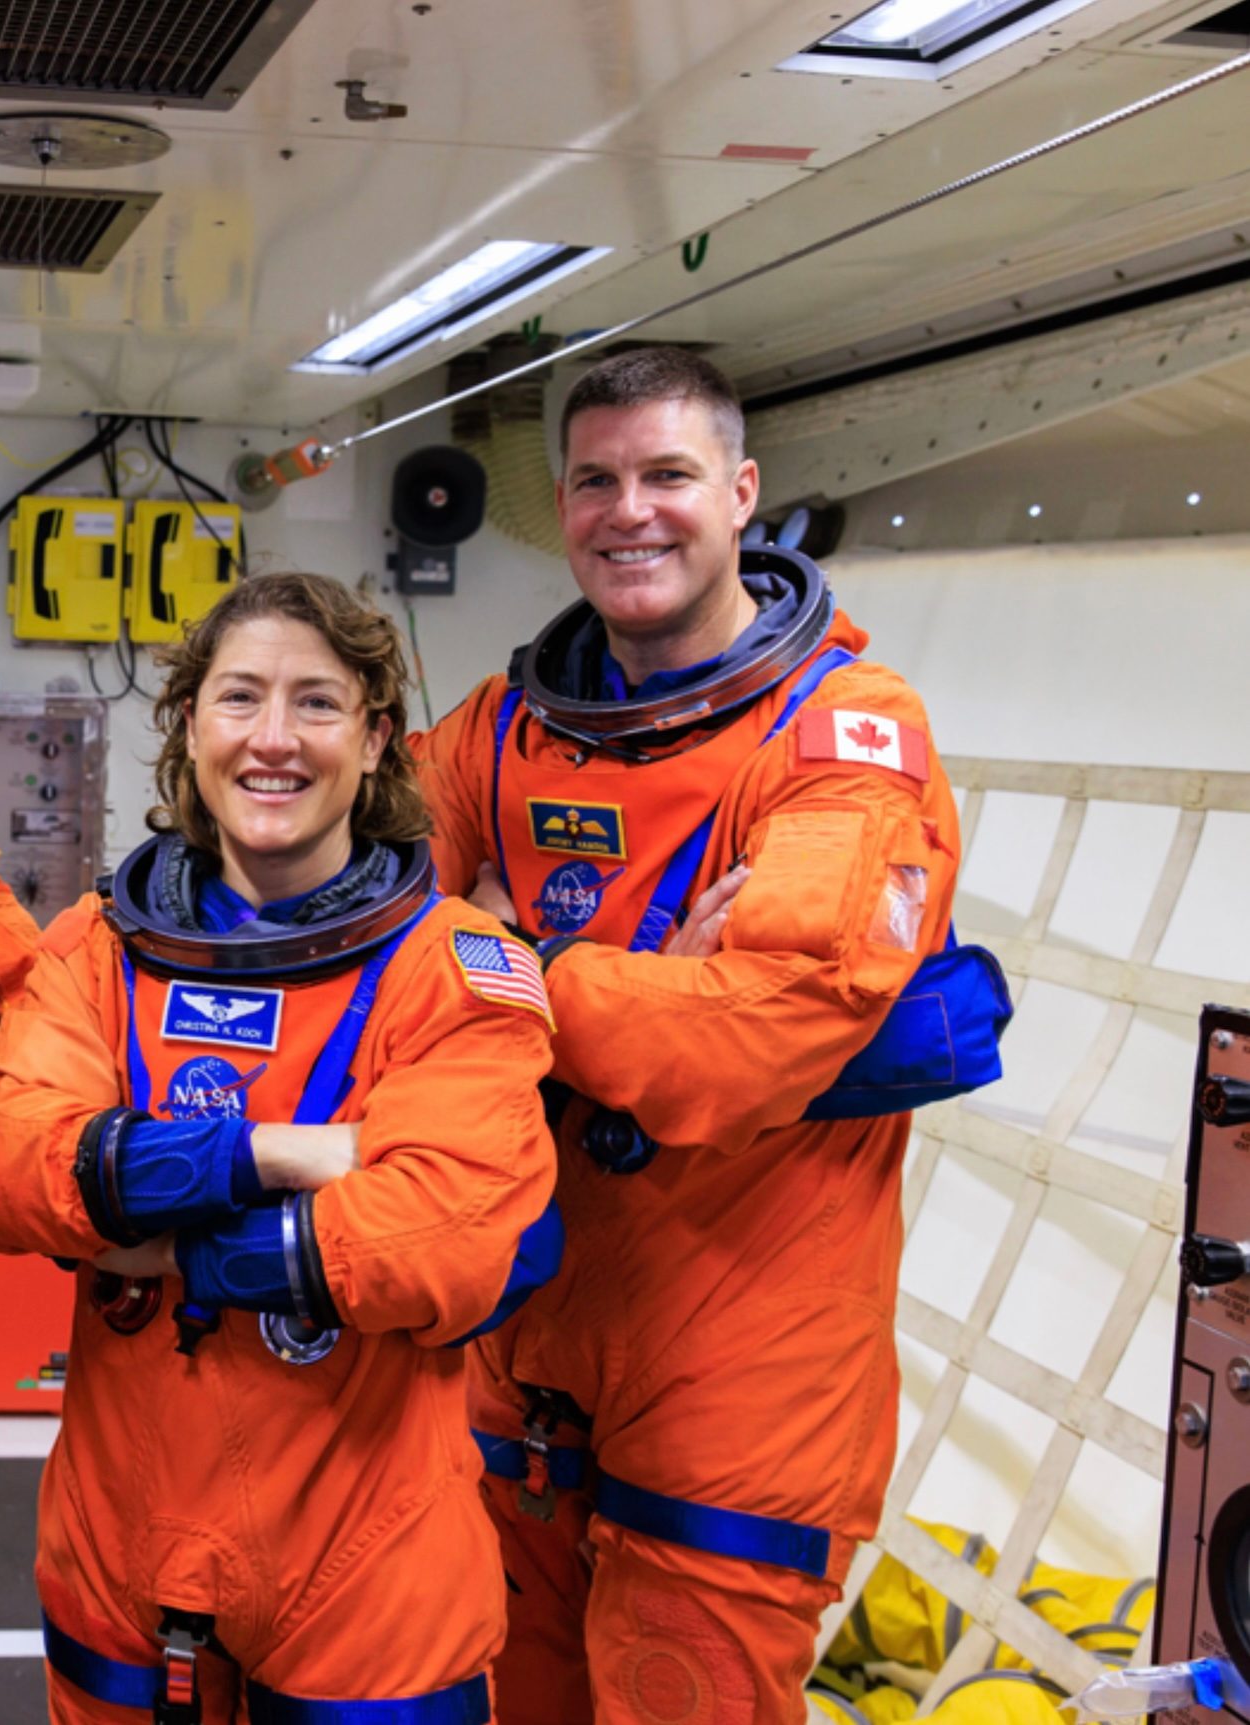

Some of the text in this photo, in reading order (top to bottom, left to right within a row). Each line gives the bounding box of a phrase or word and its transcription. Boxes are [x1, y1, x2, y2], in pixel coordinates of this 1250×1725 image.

[545, 885, 596, 907] NASA
[174, 1020, 219, 1033] CHRISTINA
[236, 1027, 262, 1039] KOCH
[174, 1085, 241, 1109] NASA
